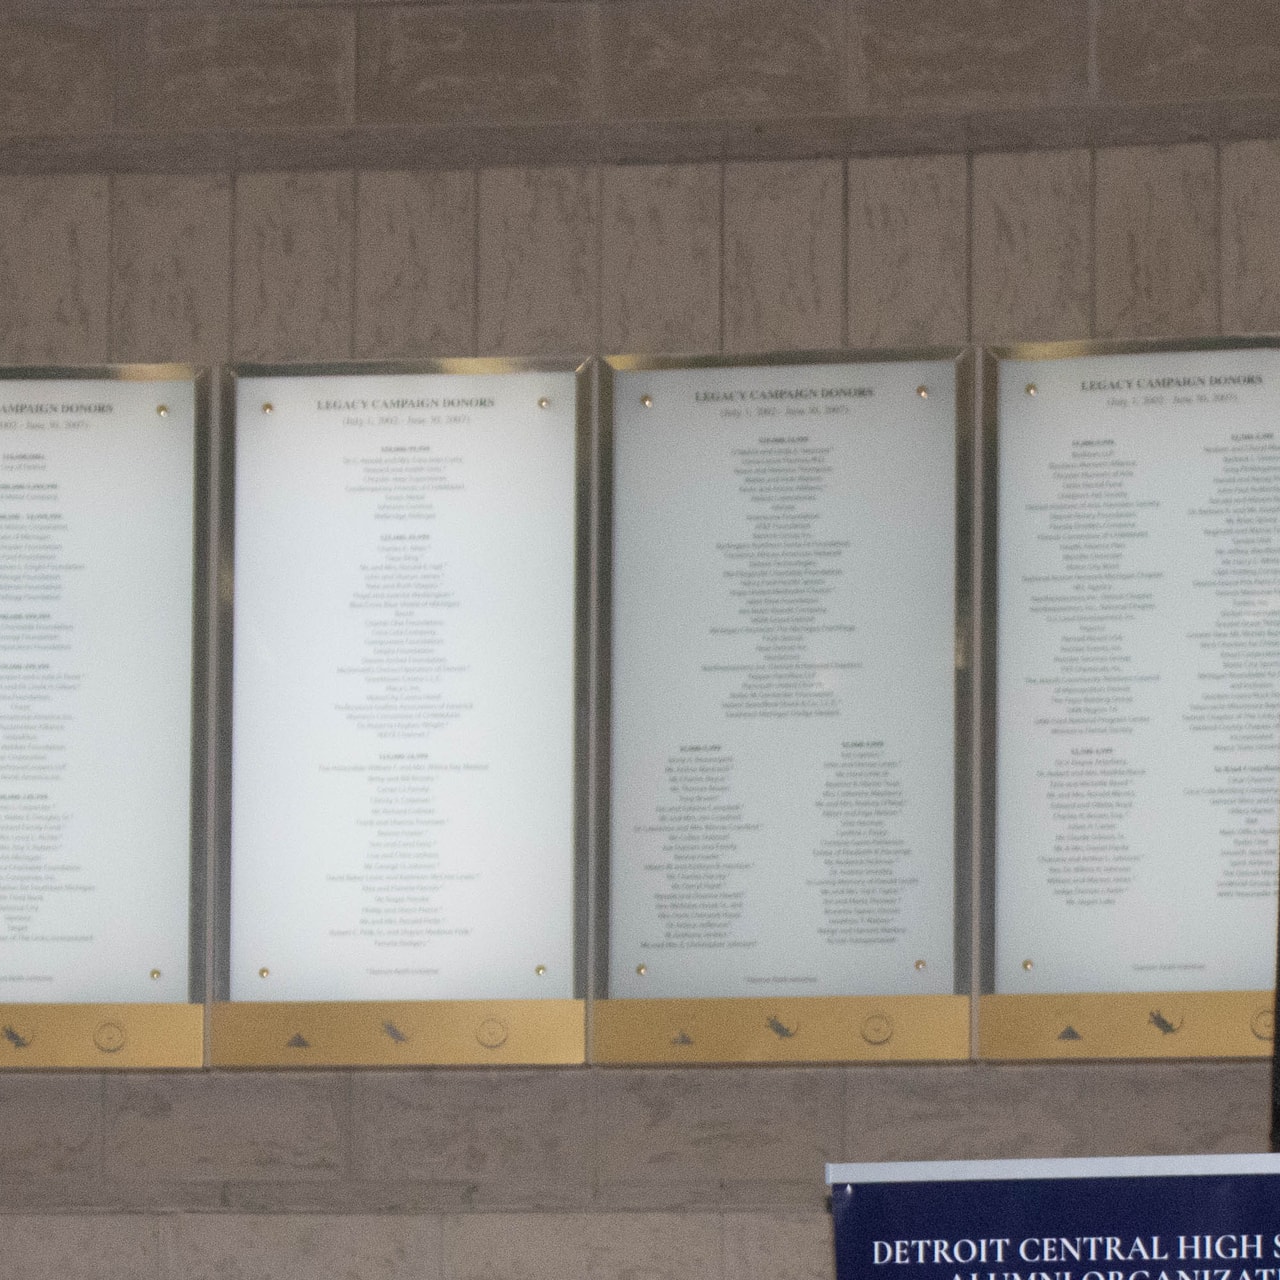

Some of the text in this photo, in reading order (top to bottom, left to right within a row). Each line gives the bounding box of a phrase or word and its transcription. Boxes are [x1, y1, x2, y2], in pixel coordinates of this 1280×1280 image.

[1081, 375, 1263, 391] LEGACY CAMPAIGN DONORS
[695, 387, 874, 402] LEGACY CAMPAIGN DONORS
[61, 403, 114, 414] DONORS
[316, 396, 495, 411] LEGACY CAMPAIGN DONORS
[873, 1238, 1010, 1265] DETROIT
[1018, 1235, 1169, 1262] CENTRAL
[1178, 1234, 1262, 1260] HIGH
